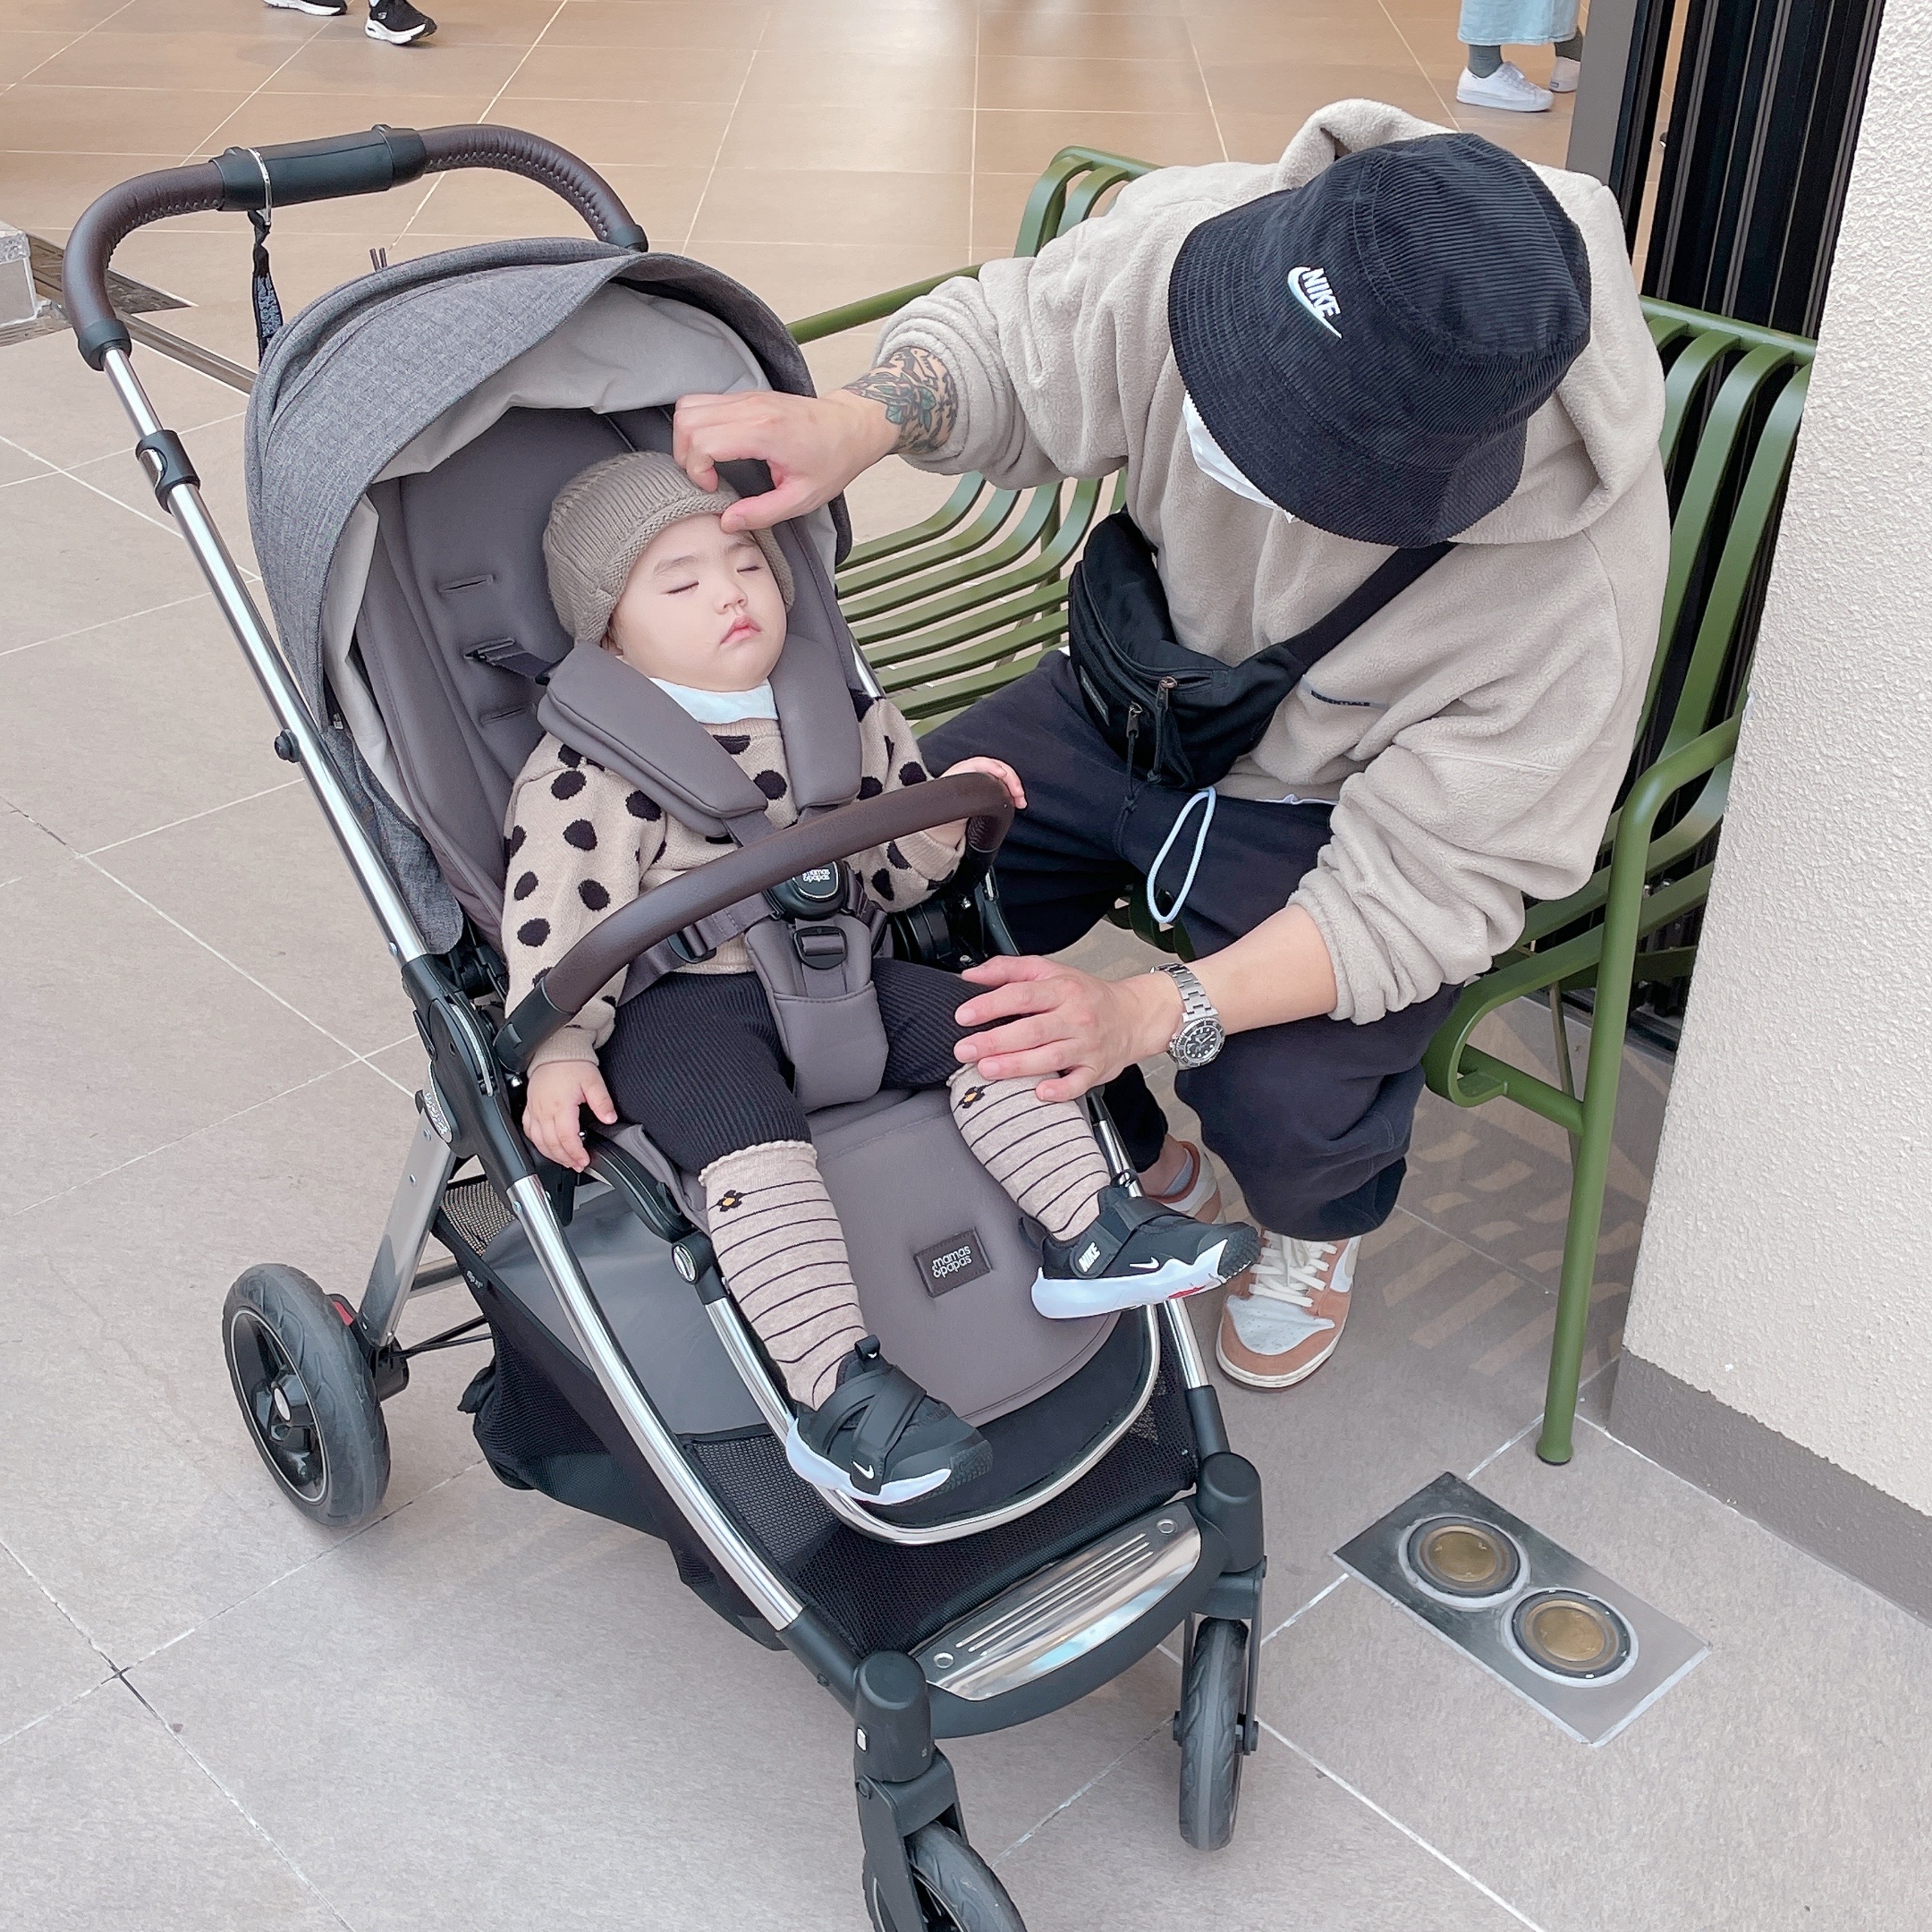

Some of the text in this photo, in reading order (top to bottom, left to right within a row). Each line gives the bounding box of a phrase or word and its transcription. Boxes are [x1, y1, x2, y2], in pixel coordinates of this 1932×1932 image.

[1301, 267, 1342, 317] NIKE
[931, 1255, 972, 1279] &papas
[932, 1245, 971, 1269] mamas
[1078, 1241, 1101, 1273] NIKE
